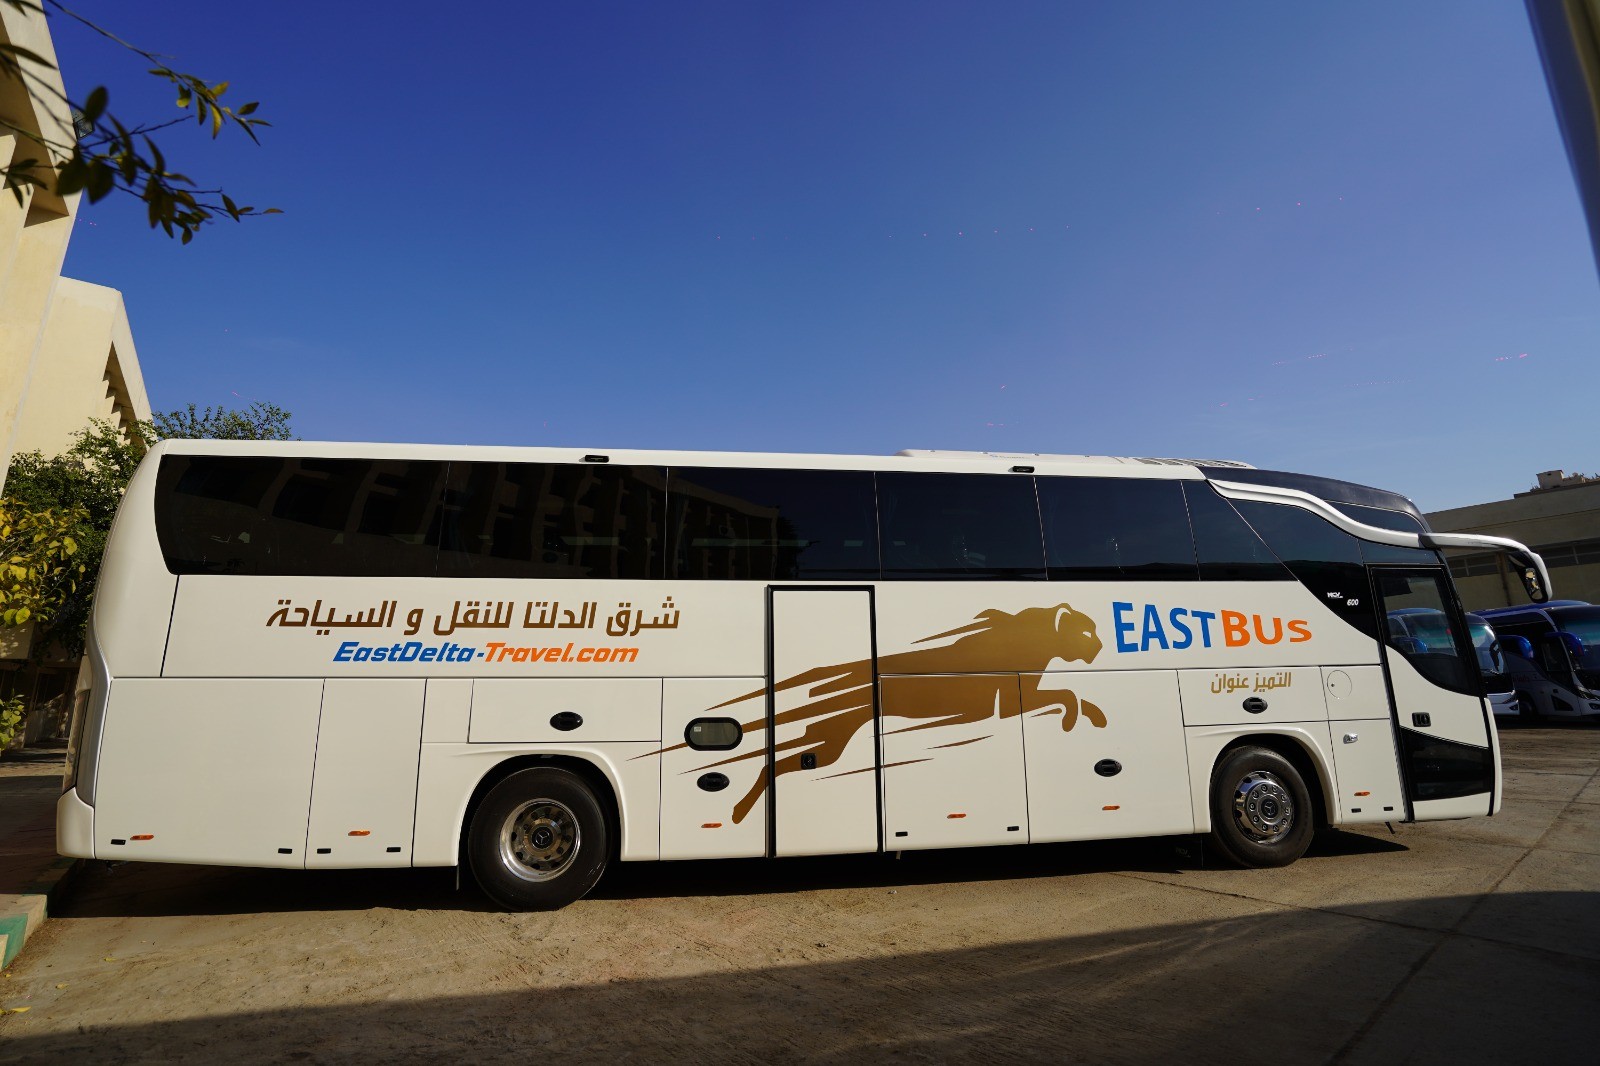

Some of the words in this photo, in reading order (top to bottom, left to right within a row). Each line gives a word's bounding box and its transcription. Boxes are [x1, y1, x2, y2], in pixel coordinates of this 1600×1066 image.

[523, 601, 597, 629] الدلتا
[1346, 598, 1359, 606] 600
[266, 599, 398, 636] السياحة
[403, 608, 424, 636] و
[433, 600, 514, 636] للنقل
[605, 596, 680, 637] شرق
[332, 641, 640, 663] EastDelta-Travel.com
[1210, 673, 1250, 694] عنوان
[1252, 671, 1292, 693] التميز
